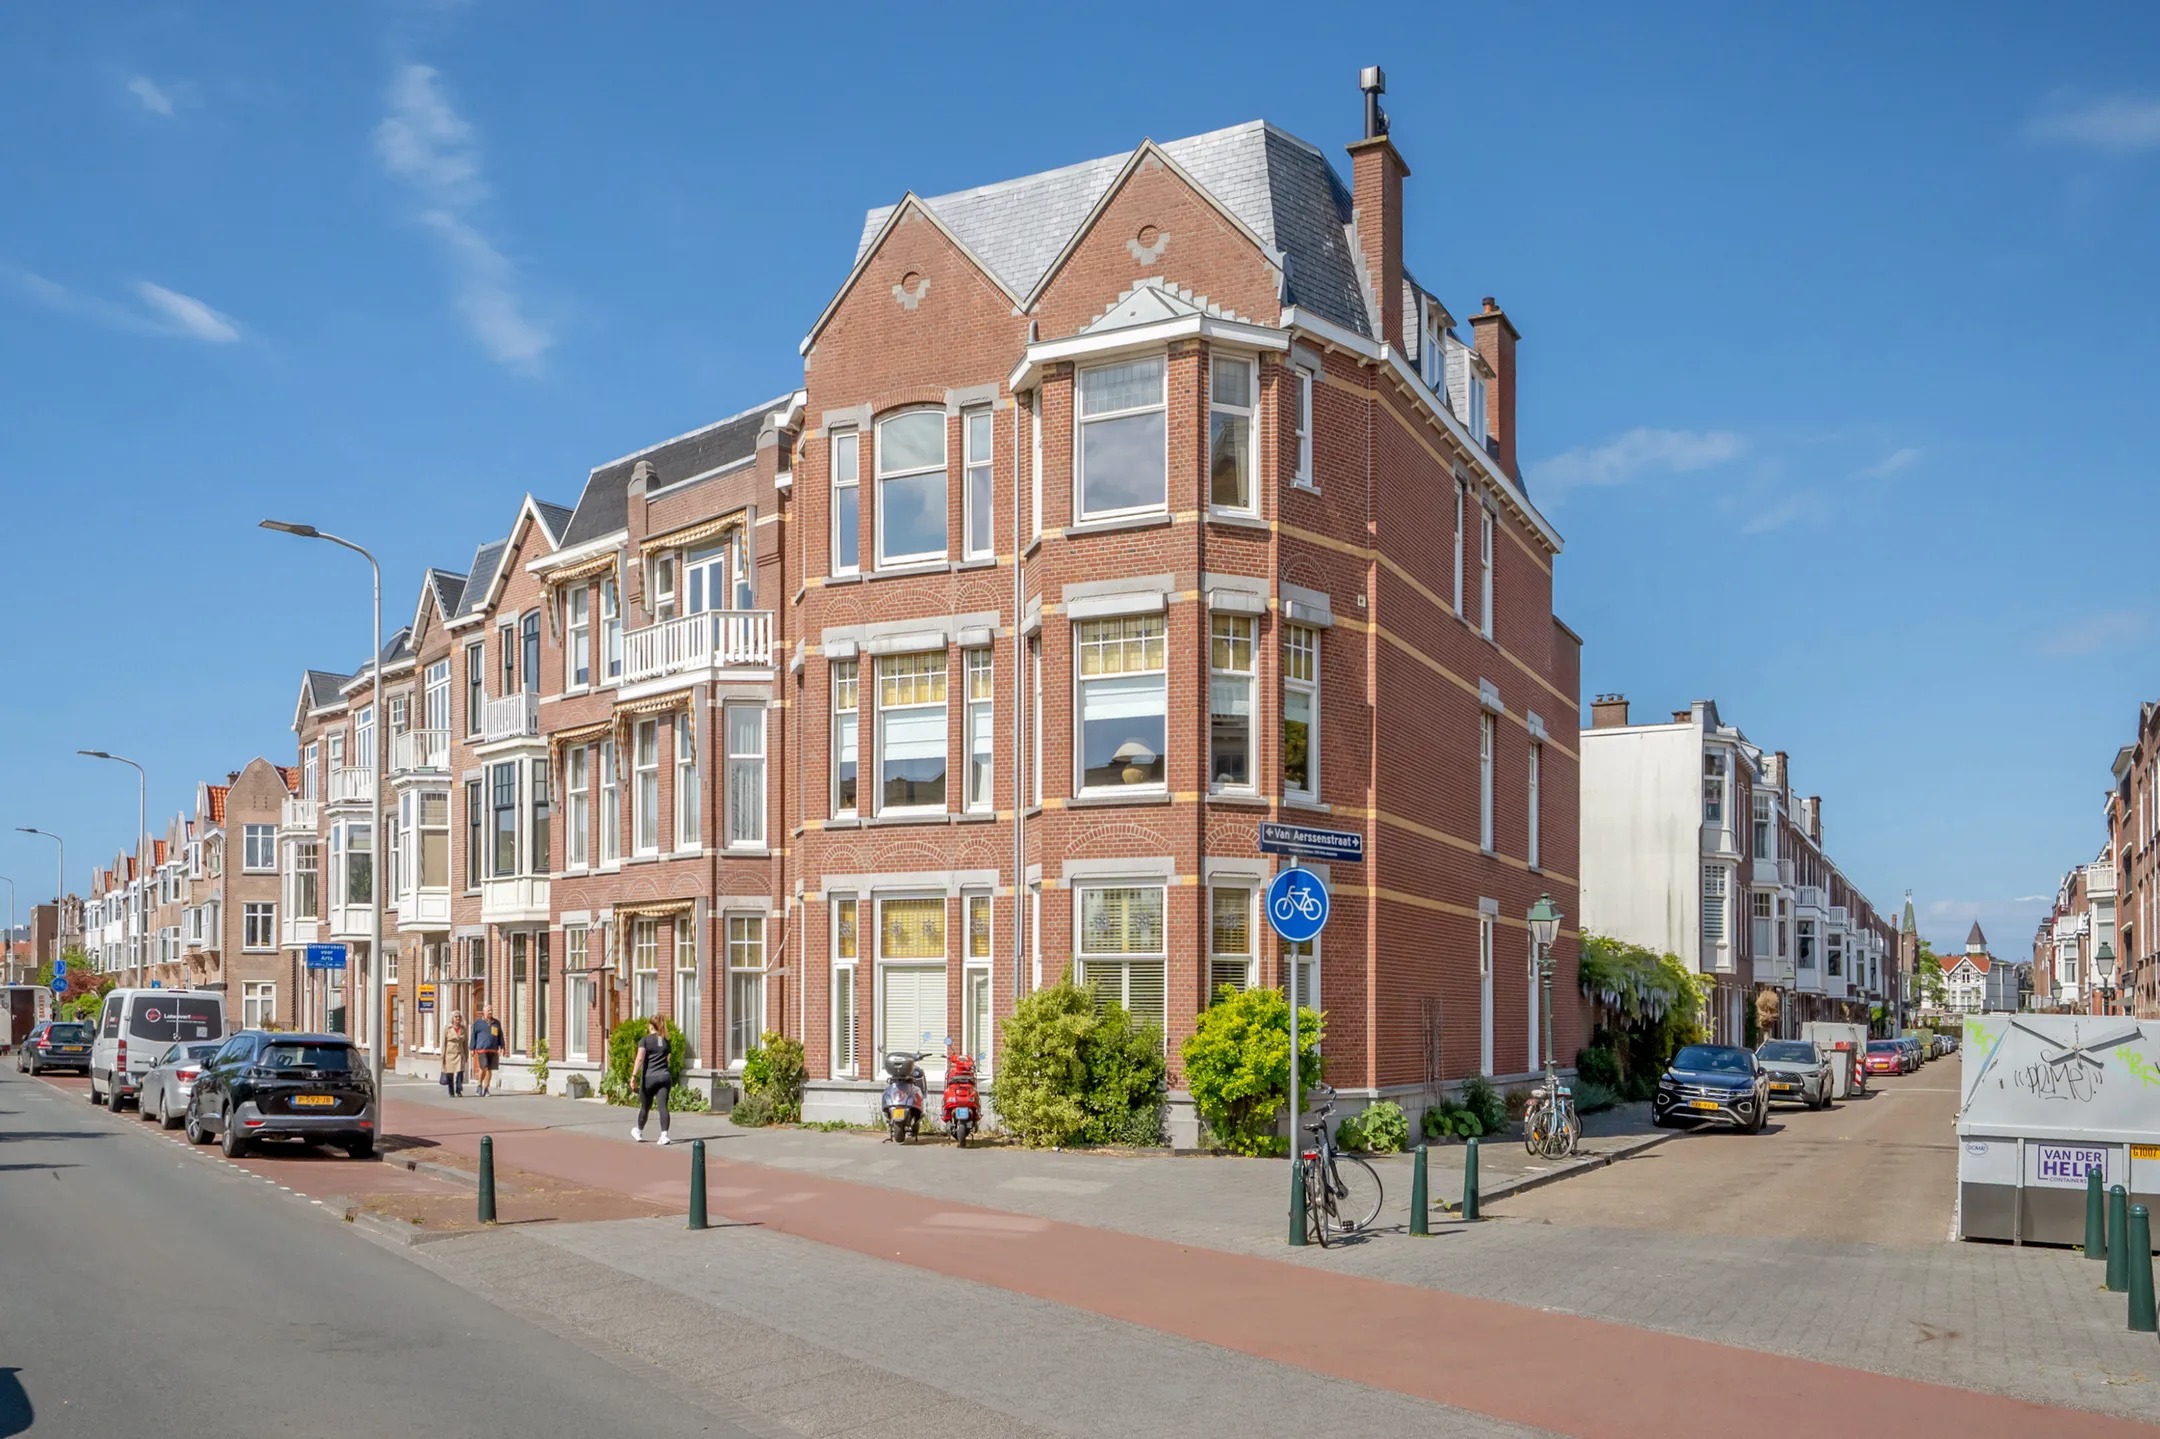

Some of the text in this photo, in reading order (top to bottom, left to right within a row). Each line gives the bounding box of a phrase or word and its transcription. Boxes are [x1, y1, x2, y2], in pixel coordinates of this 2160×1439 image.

[1274, 827, 1352, 847] Van Aerssenstraat
[2044, 1149, 2102, 1162] VAN DER
[2133, 1147, 2158, 1157] G1007
